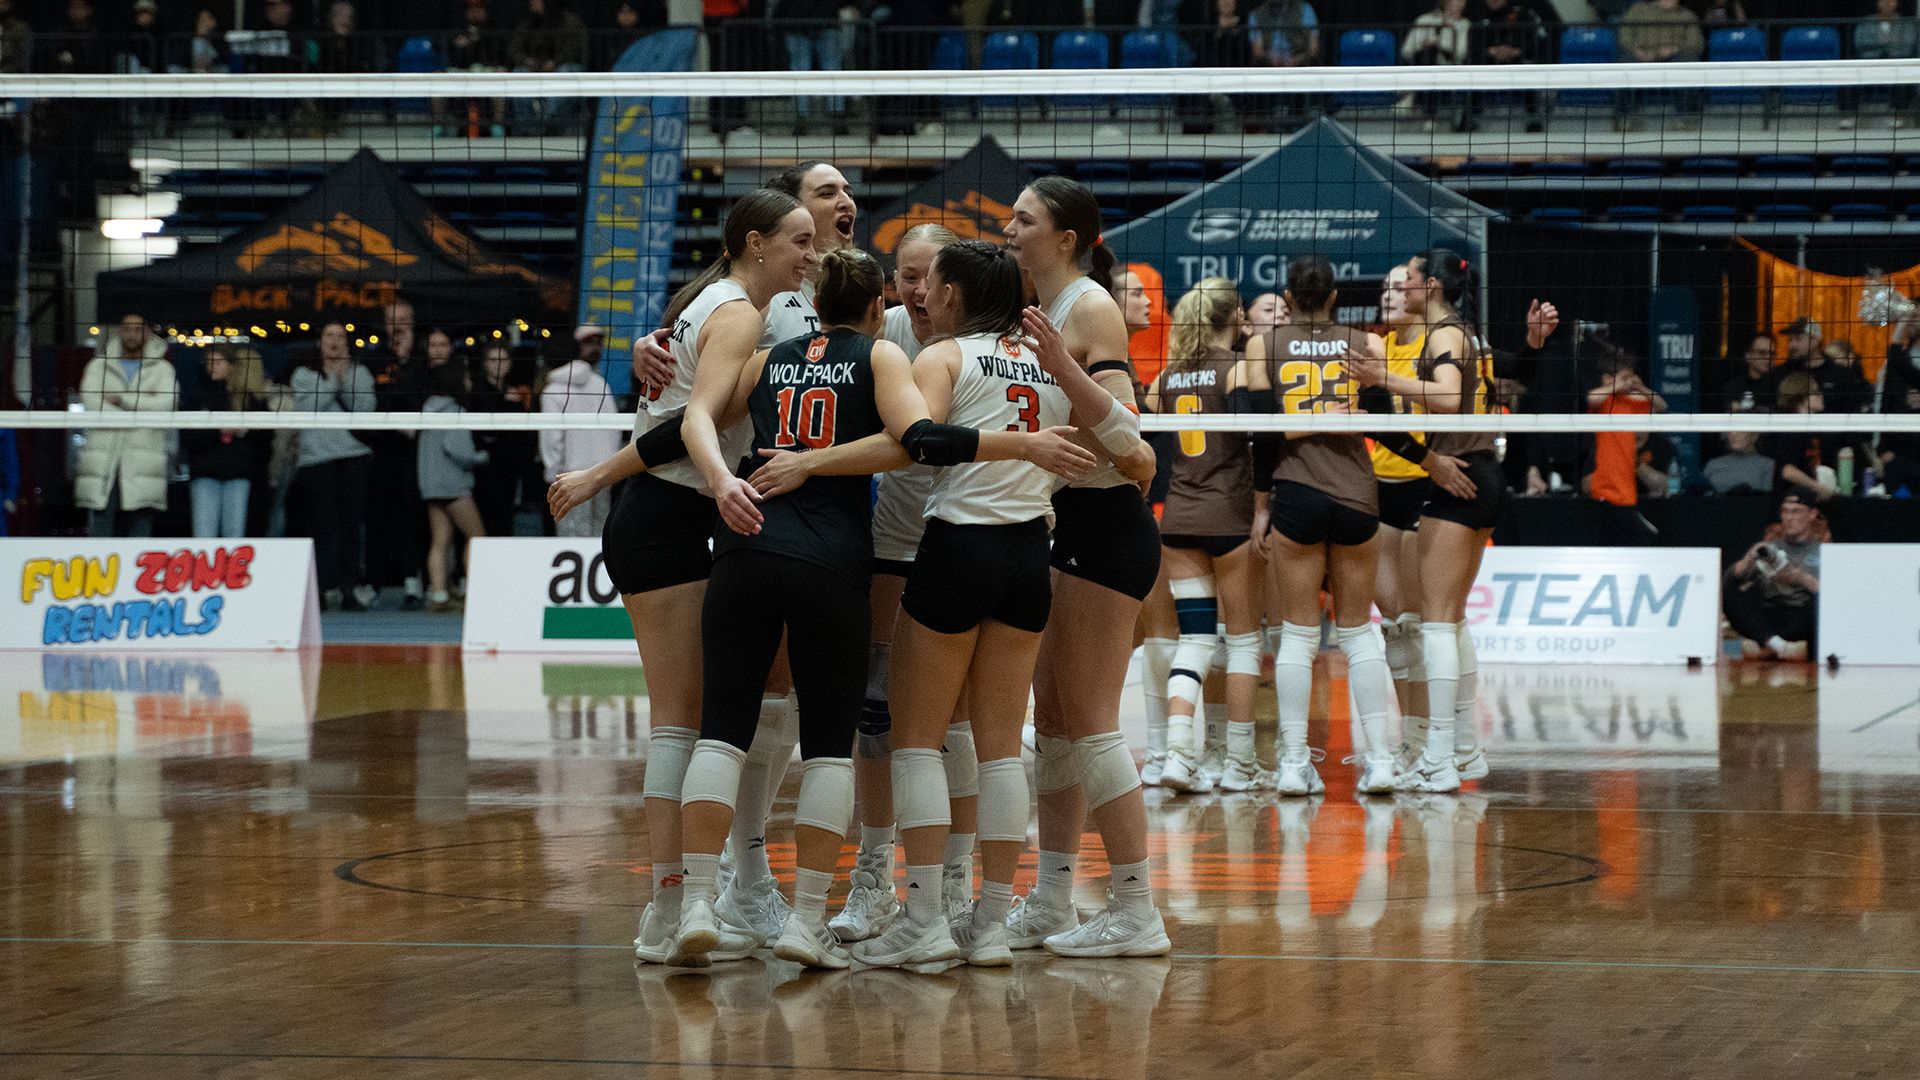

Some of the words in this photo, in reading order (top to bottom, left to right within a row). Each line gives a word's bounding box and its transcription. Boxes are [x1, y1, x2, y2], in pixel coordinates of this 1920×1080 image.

[1658, 334, 1694, 359] TRU
[769, 362, 856, 385] WOLFPACK
[1280, 360, 1361, 414] 23
[775, 386, 838, 450] 10
[1006, 383, 1040, 433] 3
[21, 553, 120, 603] FUN
[135, 545, 255, 595] ZONE
[42, 594, 224, 645] RENTALS
[1537, 636, 1616, 651] GROUP
